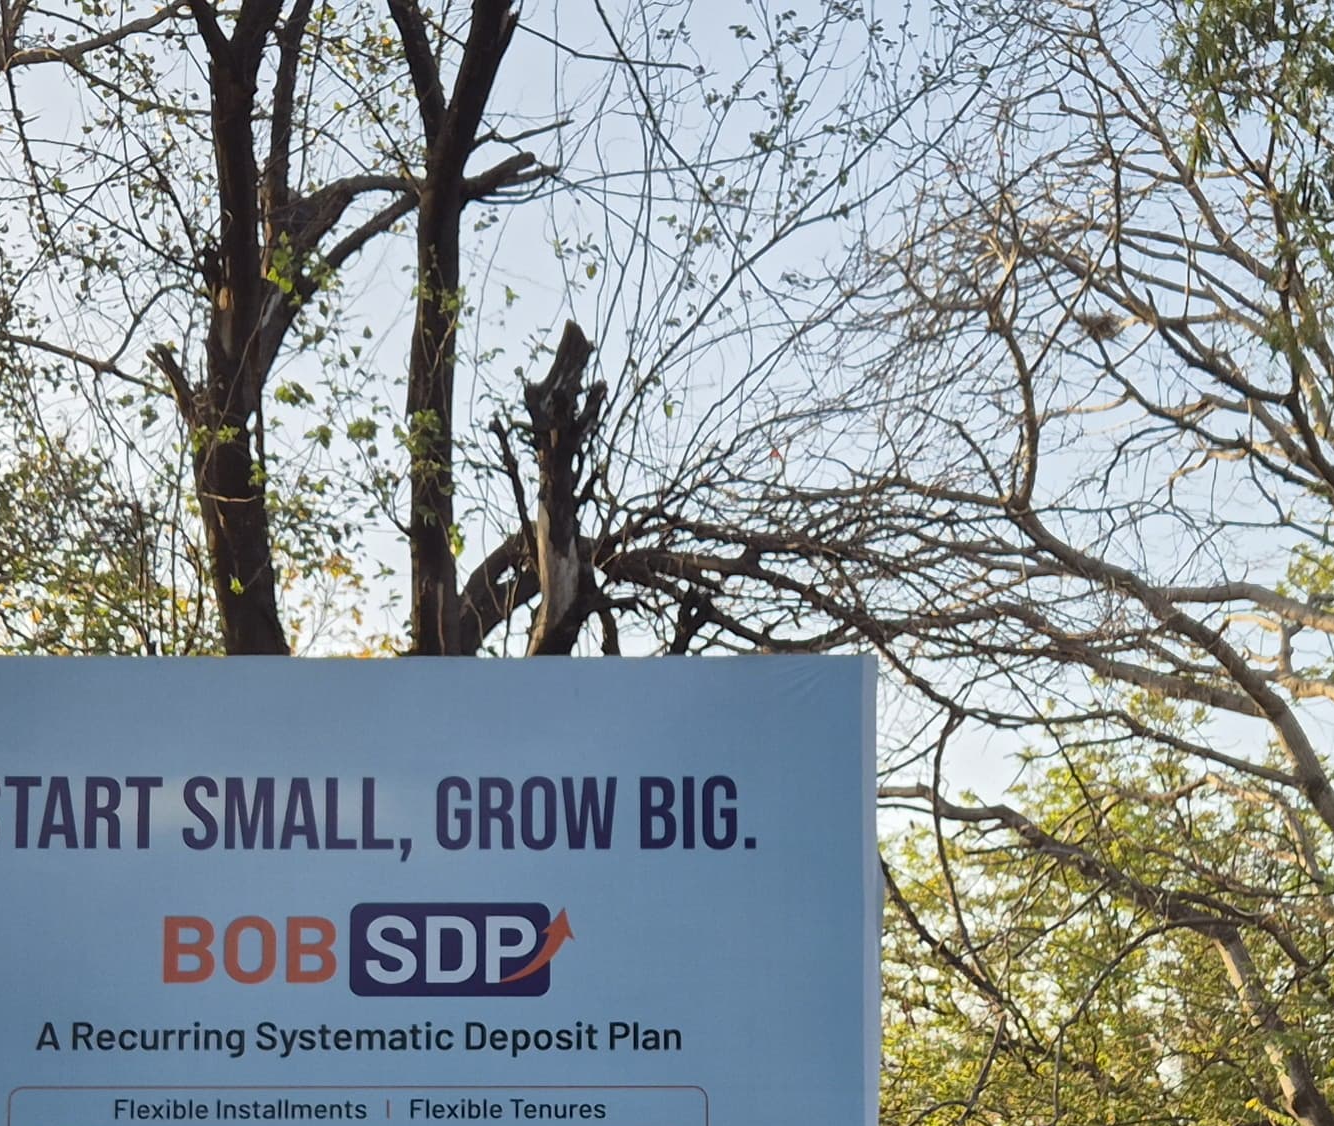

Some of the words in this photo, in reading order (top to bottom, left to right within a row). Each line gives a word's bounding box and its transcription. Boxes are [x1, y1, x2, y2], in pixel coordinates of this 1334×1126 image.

[182, 776, 411, 862] SMALL,
[436, 776, 617, 851] GROW
[640, 775, 756, 850] BIG.
[163, 916, 337, 984] BOB
[364, 915, 538, 985] SDP
[36, 1022, 60, 1050] A
[72, 1022, 245, 1058] Recurring
[256, 1022, 453, 1058] Systematic
[465, 1022, 598, 1057] Deposit
[610, 1022, 681, 1050] Plan
[114, 1099, 208, 1119] Flexible
[217, 1099, 367, 1119] Installments
[410, 1099, 502, 1119] Flexible
[510, 1099, 606, 1119] Tenures
